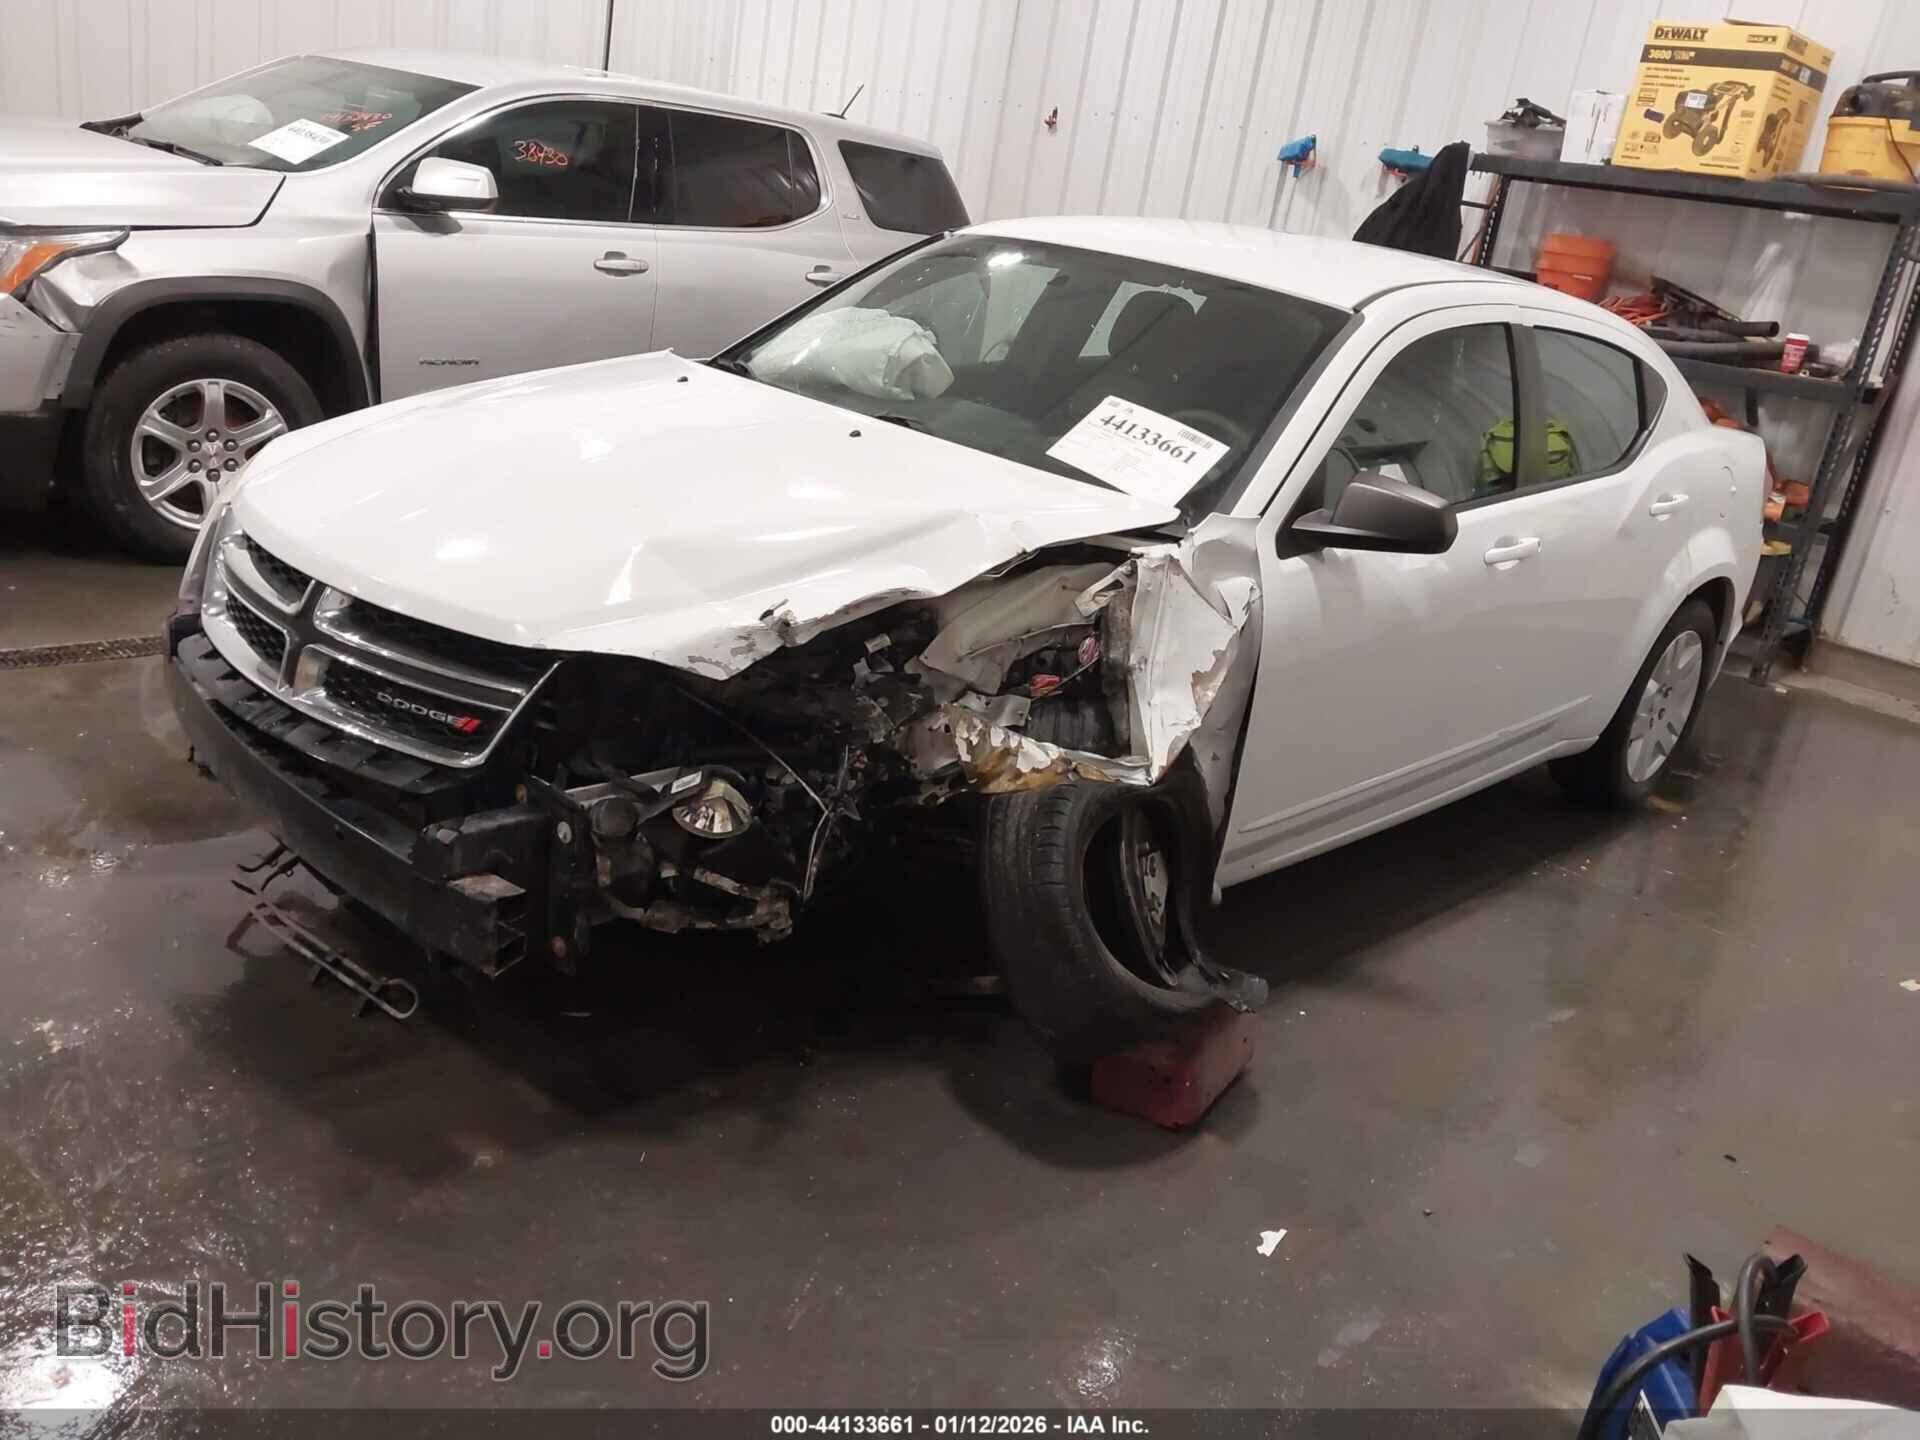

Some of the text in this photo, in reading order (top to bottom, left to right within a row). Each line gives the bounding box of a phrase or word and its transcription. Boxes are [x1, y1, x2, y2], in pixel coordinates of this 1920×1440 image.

[1653, 26, 1709, 42] DEWALT
[1100, 415, 1198, 464] 44133661
[376, 692, 463, 727] DODGE
